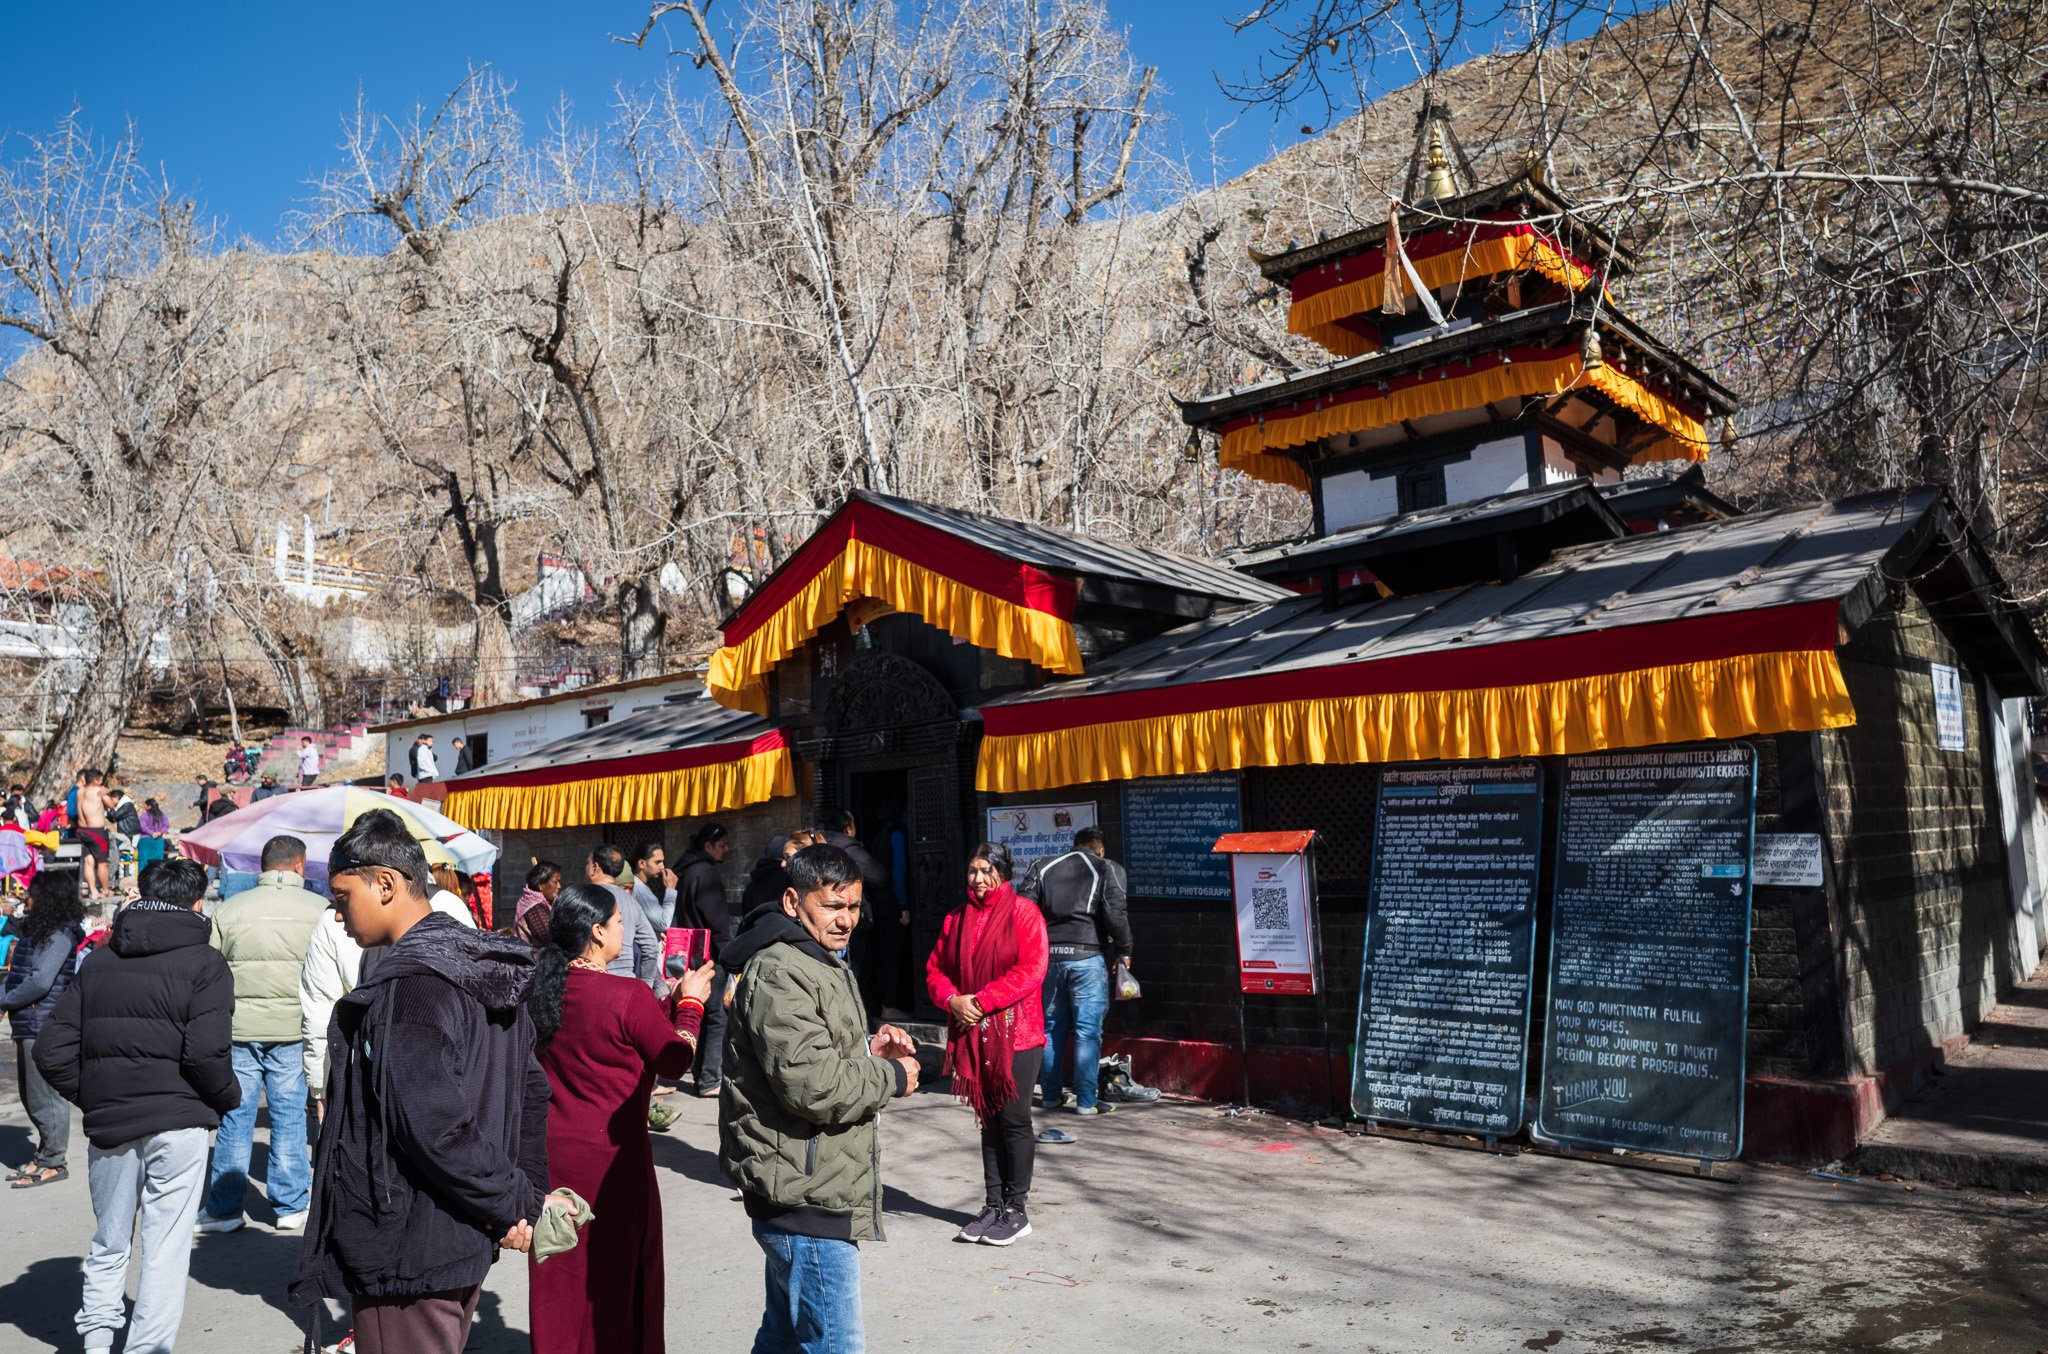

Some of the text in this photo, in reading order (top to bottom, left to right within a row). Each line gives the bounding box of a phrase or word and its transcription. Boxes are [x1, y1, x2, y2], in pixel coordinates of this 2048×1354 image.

[1568, 756, 1610, 768] MUKTINATH
[1612, 753, 1663, 767] DEVELOPMENT
[1664, 751, 1714, 764] COMMITTEE'S
[1571, 768, 1605, 781] REQUEST
[1606, 769, 1615, 780] TO
[1616, 767, 1662, 781] RESPECTED
[1136, 886, 1163, 895] INSIDE
[1166, 886, 1177, 895] NO
[1555, 999, 1702, 1024] MAY GOD MUKTINATH FULFILL
[1556, 1015, 1630, 1035] YOUR WISHES.
[1556, 1031, 1718, 1060] MAY YOUR JOURNEY TO MUKTI
[1556, 1047, 1592, 1064] REGION
[1598, 1052, 1636, 1068] BECOME
[1553, 1078, 1632, 1106] THANK YOU.
[1612, 1118, 1674, 1136] DEVELOPMENT
[1680, 1126, 1732, 1144] COMMITTEE.
